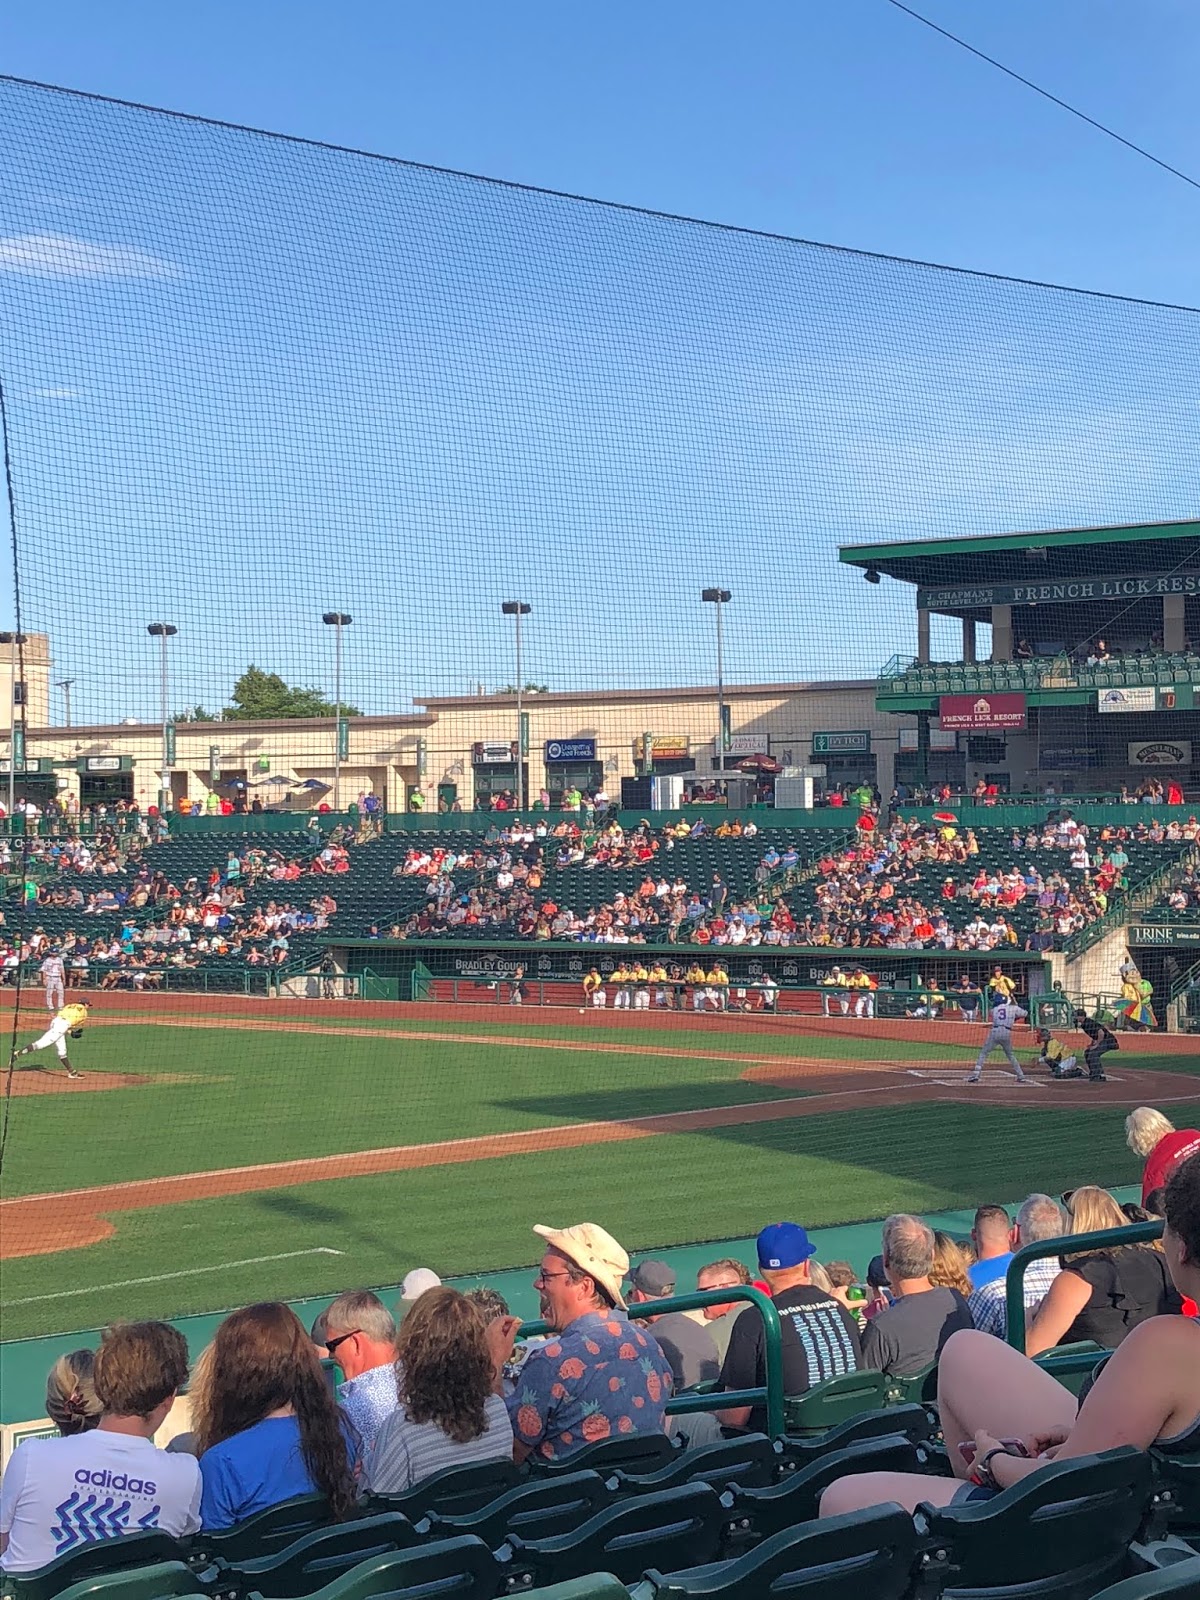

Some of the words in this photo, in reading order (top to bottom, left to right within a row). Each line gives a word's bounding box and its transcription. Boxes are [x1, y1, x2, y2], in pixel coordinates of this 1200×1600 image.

[1013, 582, 1095, 601] FRENCH
[1101, 579, 1150, 596] LICK
[1156, 576, 1200, 593] RES
[938, 589, 994, 601] CHAPMAN'S
[942, 714, 973, 723] FRENCH
[974, 713, 992, 722] LICK
[1133, 927, 1173, 940] TRINE
[455, 959, 496, 971] BRADLEY
[997, 1008, 1006, 1020] 3
[74, 1468, 157, 1496] adidas
